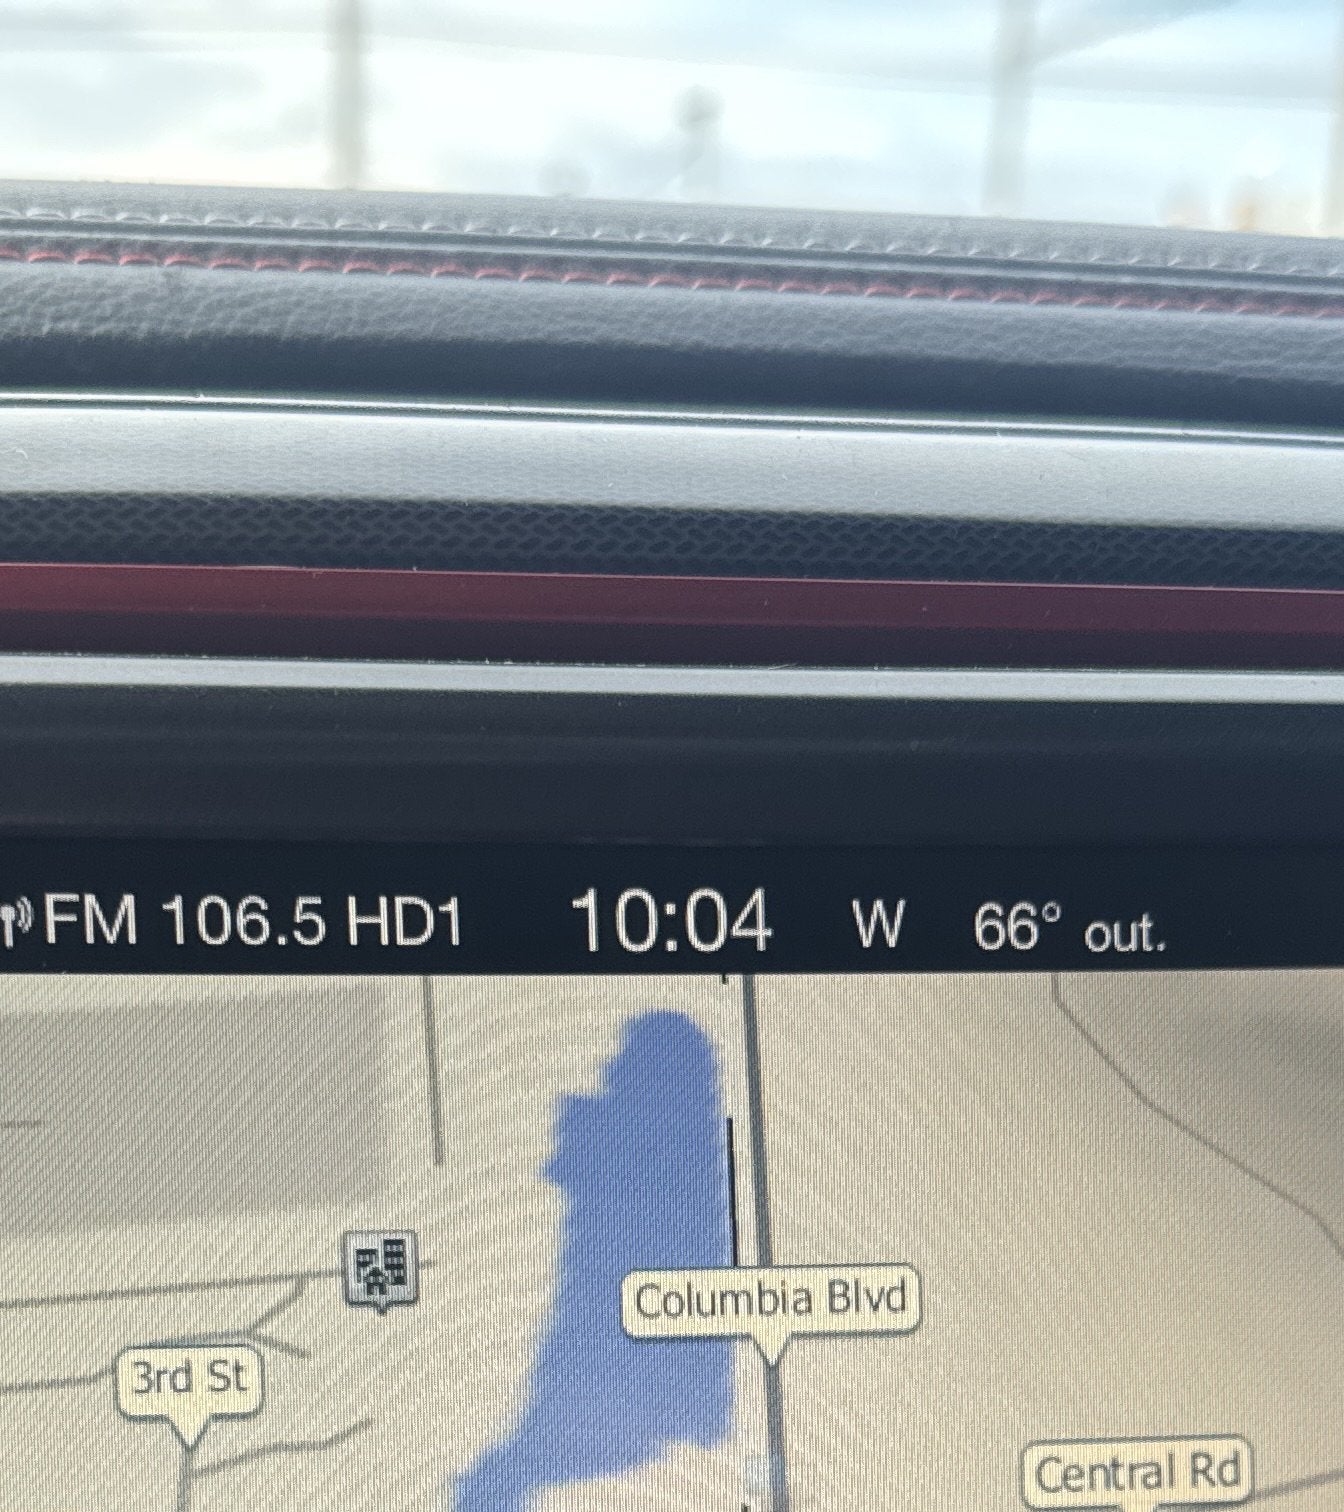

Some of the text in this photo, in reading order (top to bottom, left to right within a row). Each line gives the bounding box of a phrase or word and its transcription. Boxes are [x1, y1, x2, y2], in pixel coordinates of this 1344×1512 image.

[45, 894, 461, 946] FM 106.5 HD1
[571, 887, 773, 953] 10:04
[851, 898, 906, 950] W
[973, 901, 1167, 954] 66° out.
[634, 1278, 908, 1318] Columbia Blvd
[132, 1358, 248, 1396] 3rd St
[1034, 1452, 1242, 1493] Central Rd
